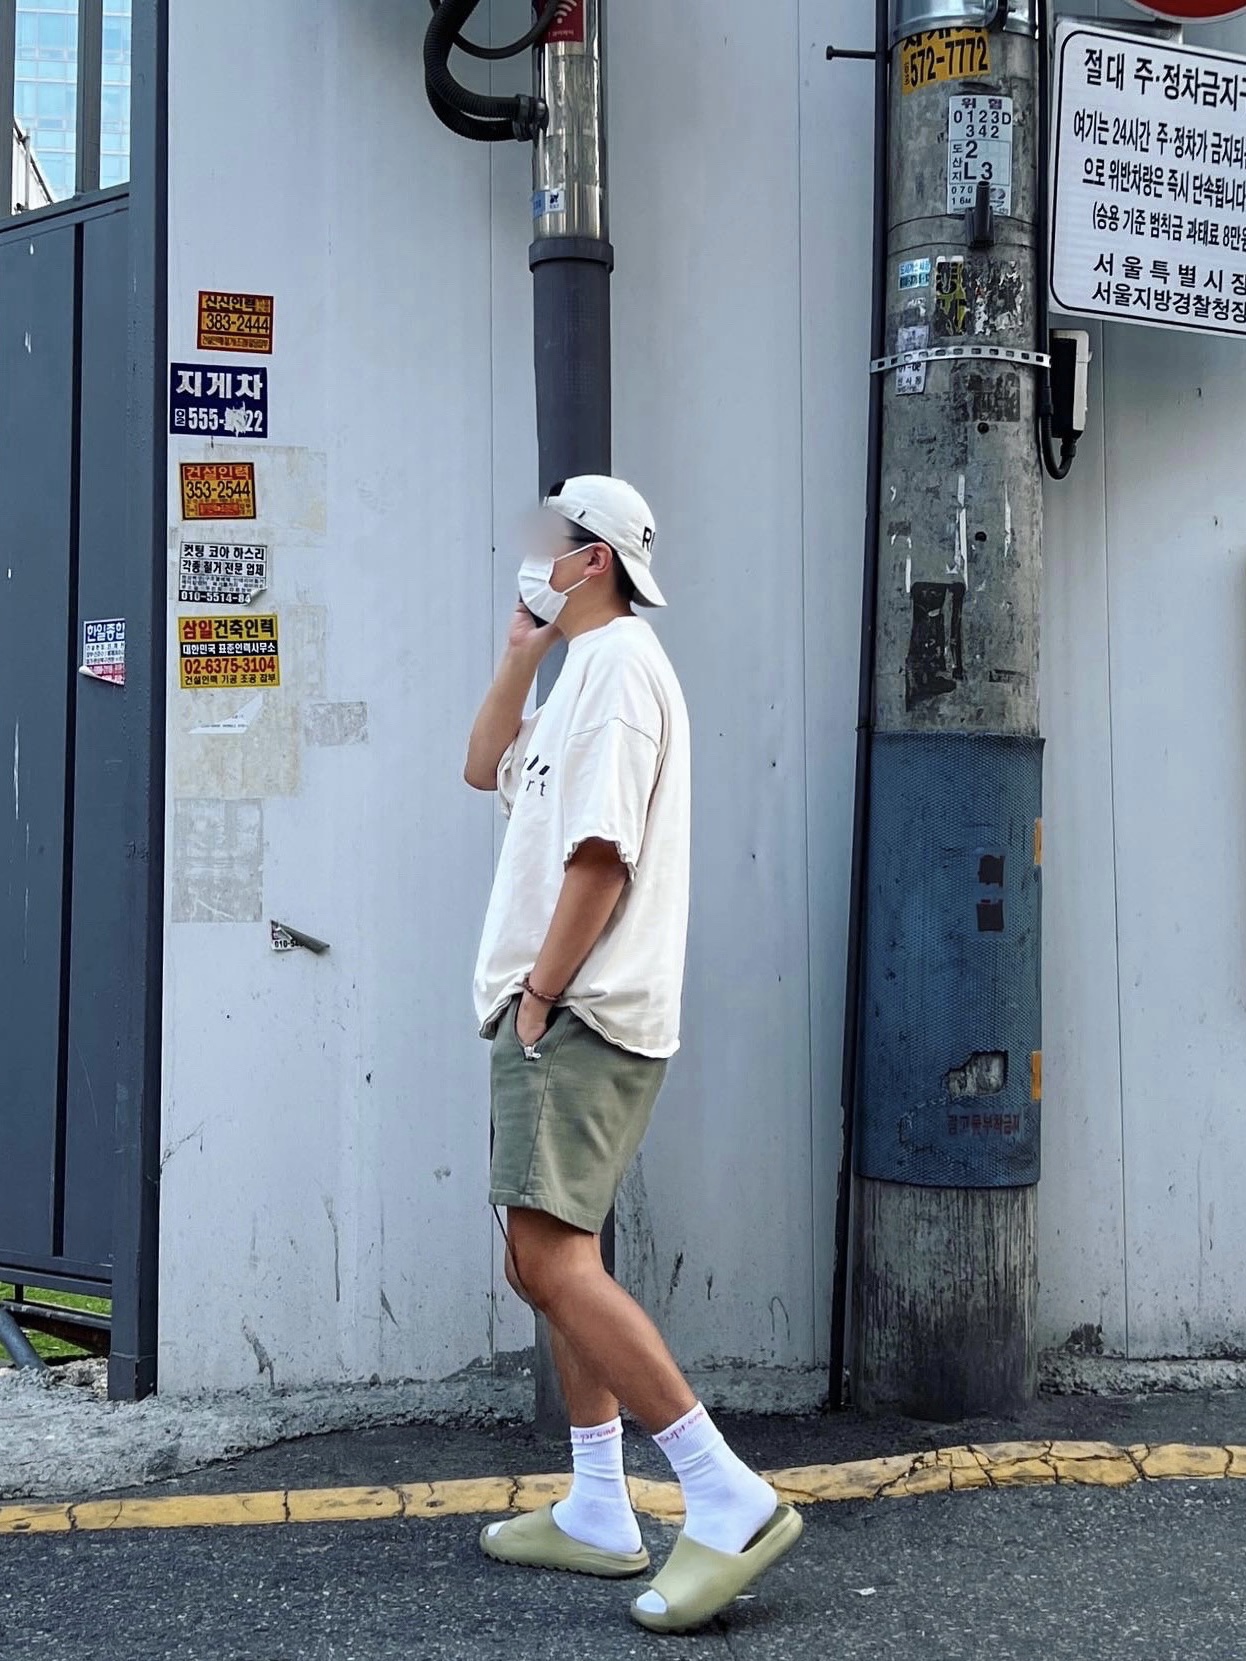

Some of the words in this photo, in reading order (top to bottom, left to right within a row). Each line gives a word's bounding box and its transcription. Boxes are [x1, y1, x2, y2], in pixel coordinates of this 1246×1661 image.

[910, 36, 988, 87] 572-7772
[1084, 48, 1125, 91] 절대
[1073, 108, 1109, 145] 여기는
[1112, 117, 1150, 152] 24시간
[1211, 132, 1246, 169] 금지되
[1082, 158, 1105, 186] 으로
[1108, 159, 1164, 198] 위반차량은
[1167, 169, 1189, 203] 즉시
[1192, 173, 1246, 213] 단속됩니다
[1092, 201, 1119, 232] (승용
[1123, 208, 1146, 235] 기준
[1150, 211, 1183, 241] 범칙금
[1186, 217, 1219, 246] 과태료
[1092, 281, 1246, 323] 서울지방경찰청장
[206, 312, 269, 332] 383-2444
[175, 370, 263, 400] 지게차
[188, 407, 263, 433] 555-22
[186, 466, 249, 480] 건설인력
[186, 481, 251, 499] 353-2544
[208, 546, 230, 559] 코아
[233, 547, 265, 560] 하스리
[182, 559, 200, 573] 각종
[203, 561, 222, 574] 철거
[225, 562, 243, 575] 전문
[246, 563, 264, 576] 업체
[182, 618, 274, 640] 삼일건축인력
[182, 643, 216, 655] 대한민국
[218, 642, 276, 654] 표준인력사무소
[184, 656, 275, 675] 02-6375-3104
